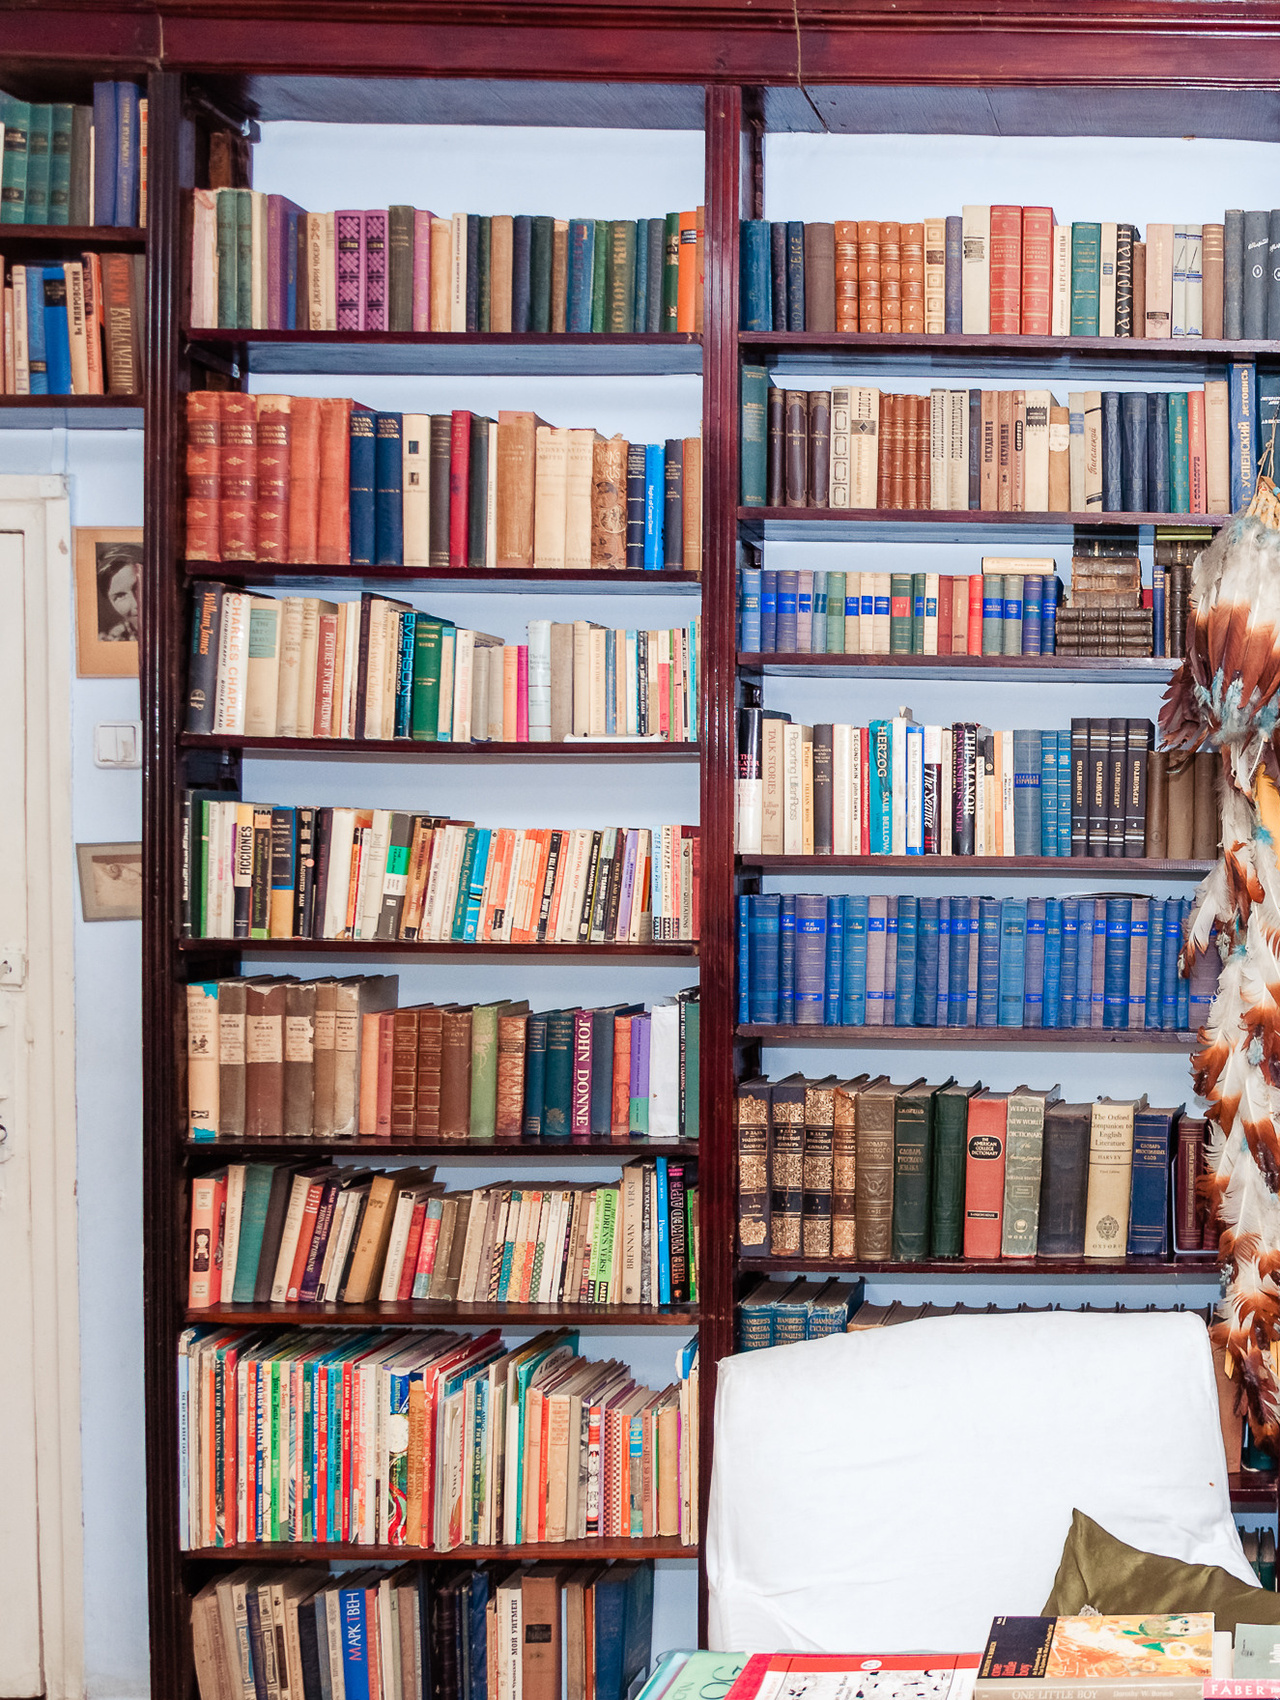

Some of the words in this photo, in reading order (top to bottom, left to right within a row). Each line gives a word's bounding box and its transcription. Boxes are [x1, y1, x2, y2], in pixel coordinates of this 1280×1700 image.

[1059, 235, 1067, 293] ПЕРЕСЕЛЕНЦЫ
[985, 421, 994, 463] ОСКУДЕНИЕ
[1087, 427, 1098, 475] Писемский
[203, 592, 216, 628] William
[199, 625, 213, 656] James
[229, 596, 242, 662] CHARLES
[324, 632, 335, 667] PICTURES
[402, 612, 416, 697] EMERSON
[226, 666, 239, 728] CHAPLIN
[322, 676, 334, 693] THE
[321, 697, 333, 729] HALLWAY
[768, 728, 776, 755] TALK
[788, 731, 799, 774] Reporting
[877, 726, 888, 777] HERZOG
[964, 730, 976, 758] THE
[768, 755, 776, 795] STORIES
[925, 768, 937, 791] The
[963, 760, 975, 815] MANOR
[882, 791, 891, 813] SAUL
[924, 792, 936, 828] Seance
[881, 816, 890, 851] BELLOW
[240, 826, 252, 877] FICCIONES
[464, 846, 474, 867] Lonely
[576, 840, 585, 871] BORSTAL
[591, 844, 599, 864] GREEN
[461, 870, 471, 891] Crowd
[587, 864, 595, 896] MANSIONS
[577, 1019, 591, 1062] JOHN
[576, 1068, 590, 1127] DONNE
[1095, 1139, 1126, 1147] Literature
[1099, 1131, 1122, 1139] English
[627, 1180, 635, 1208] VERSE
[671, 1181, 685, 1208] APE
[601, 1193, 612, 1245] CHILDREN'S
[671, 1210, 685, 1254] NAKED
[598, 1247, 609, 1275] VERSE
[626, 1223, 635, 1270] BRENNAN
[671, 1256, 685, 1285] THE
[599, 1282, 609, 1301] FABER
[394, 1376, 404, 1411] American
[416, 1415, 424, 1452] HARVEST
[475, 1415, 482, 1423] IS
[415, 1454, 423, 1464] OF
[407, 1453, 416, 1499] LITERATURE
[414, 1467, 422, 1500] RUSSIAN
[346, 1592, 360, 1624] ТВЕН
[348, 1626, 362, 1661] МАРК
[1011, 1690, 1035, 1699] ONE
[1038, 1690, 1074, 1699] LITTLE
[1077, 1690, 1098, 1699] BOY
[1211, 1682, 1265, 1696] FABER
